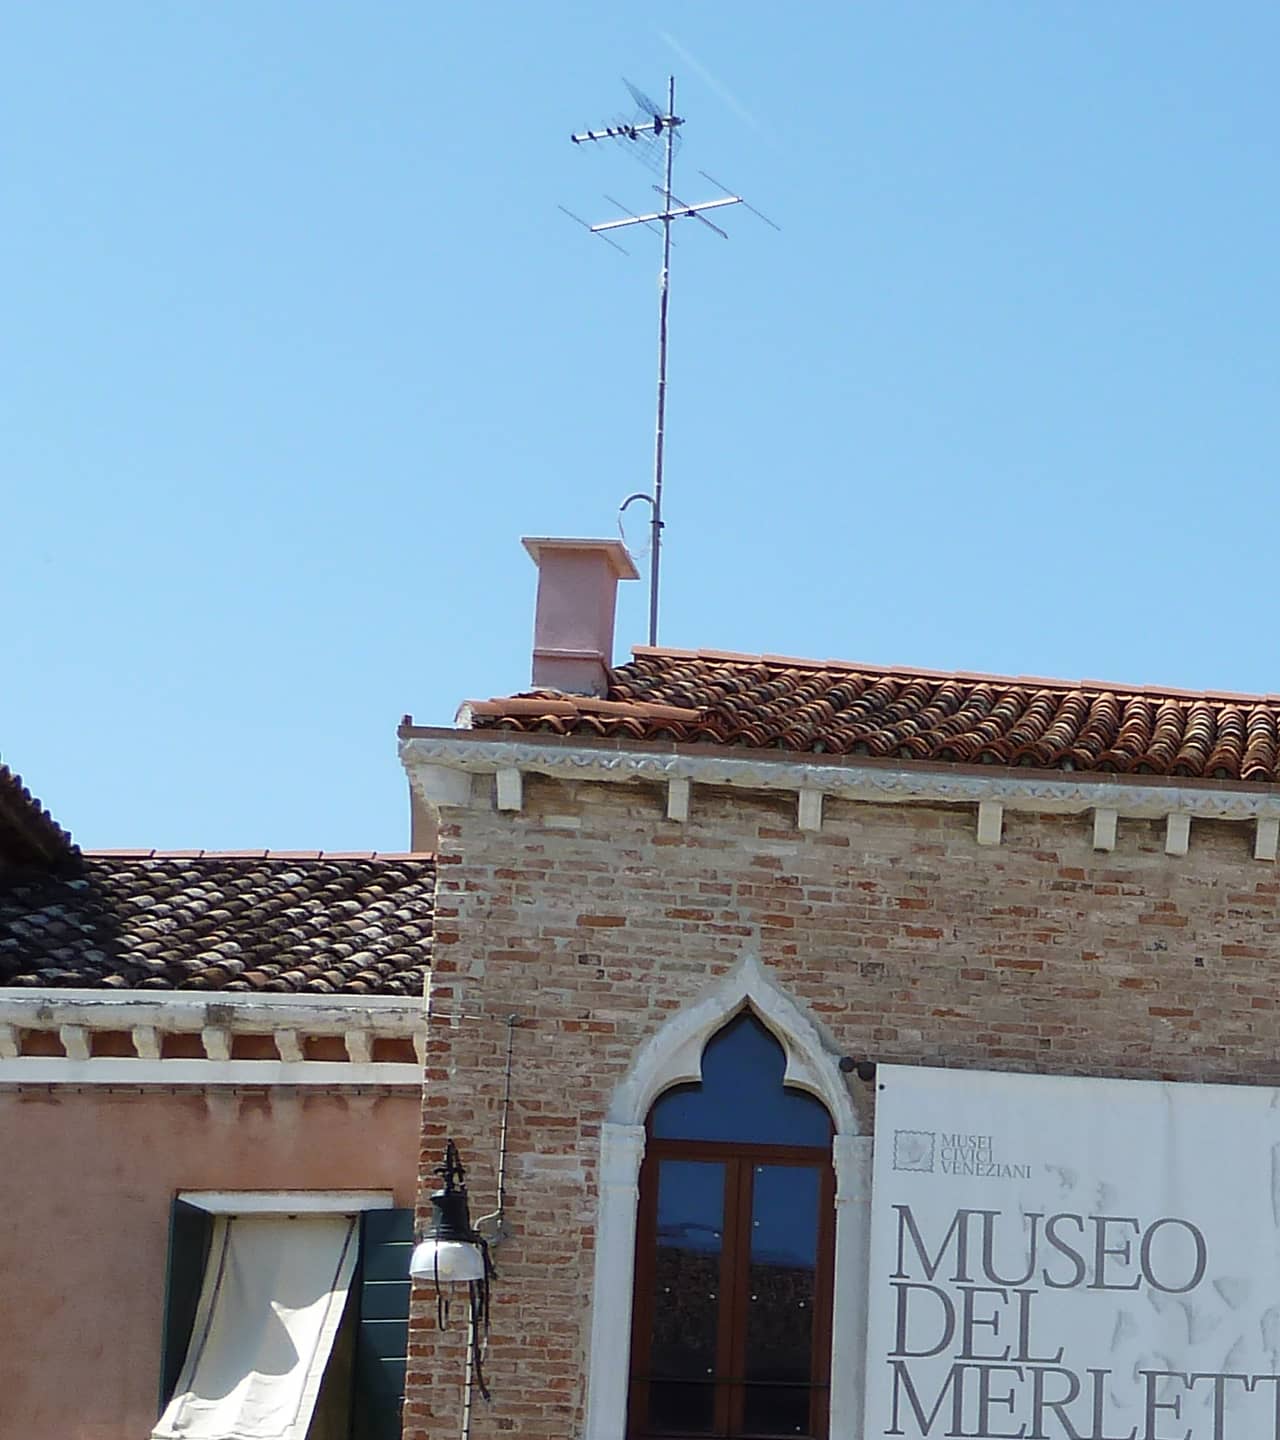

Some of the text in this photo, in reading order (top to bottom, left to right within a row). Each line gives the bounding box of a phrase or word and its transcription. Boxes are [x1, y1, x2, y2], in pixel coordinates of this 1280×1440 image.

[942, 1133, 993, 1149] MUSEI
[941, 1147, 993, 1163] CIVICI
[941, 1160, 1031, 1179] VENEZIANI
[889, 1204, 1208, 1293] MUSEO
[887, 1282, 1064, 1364] DEL
